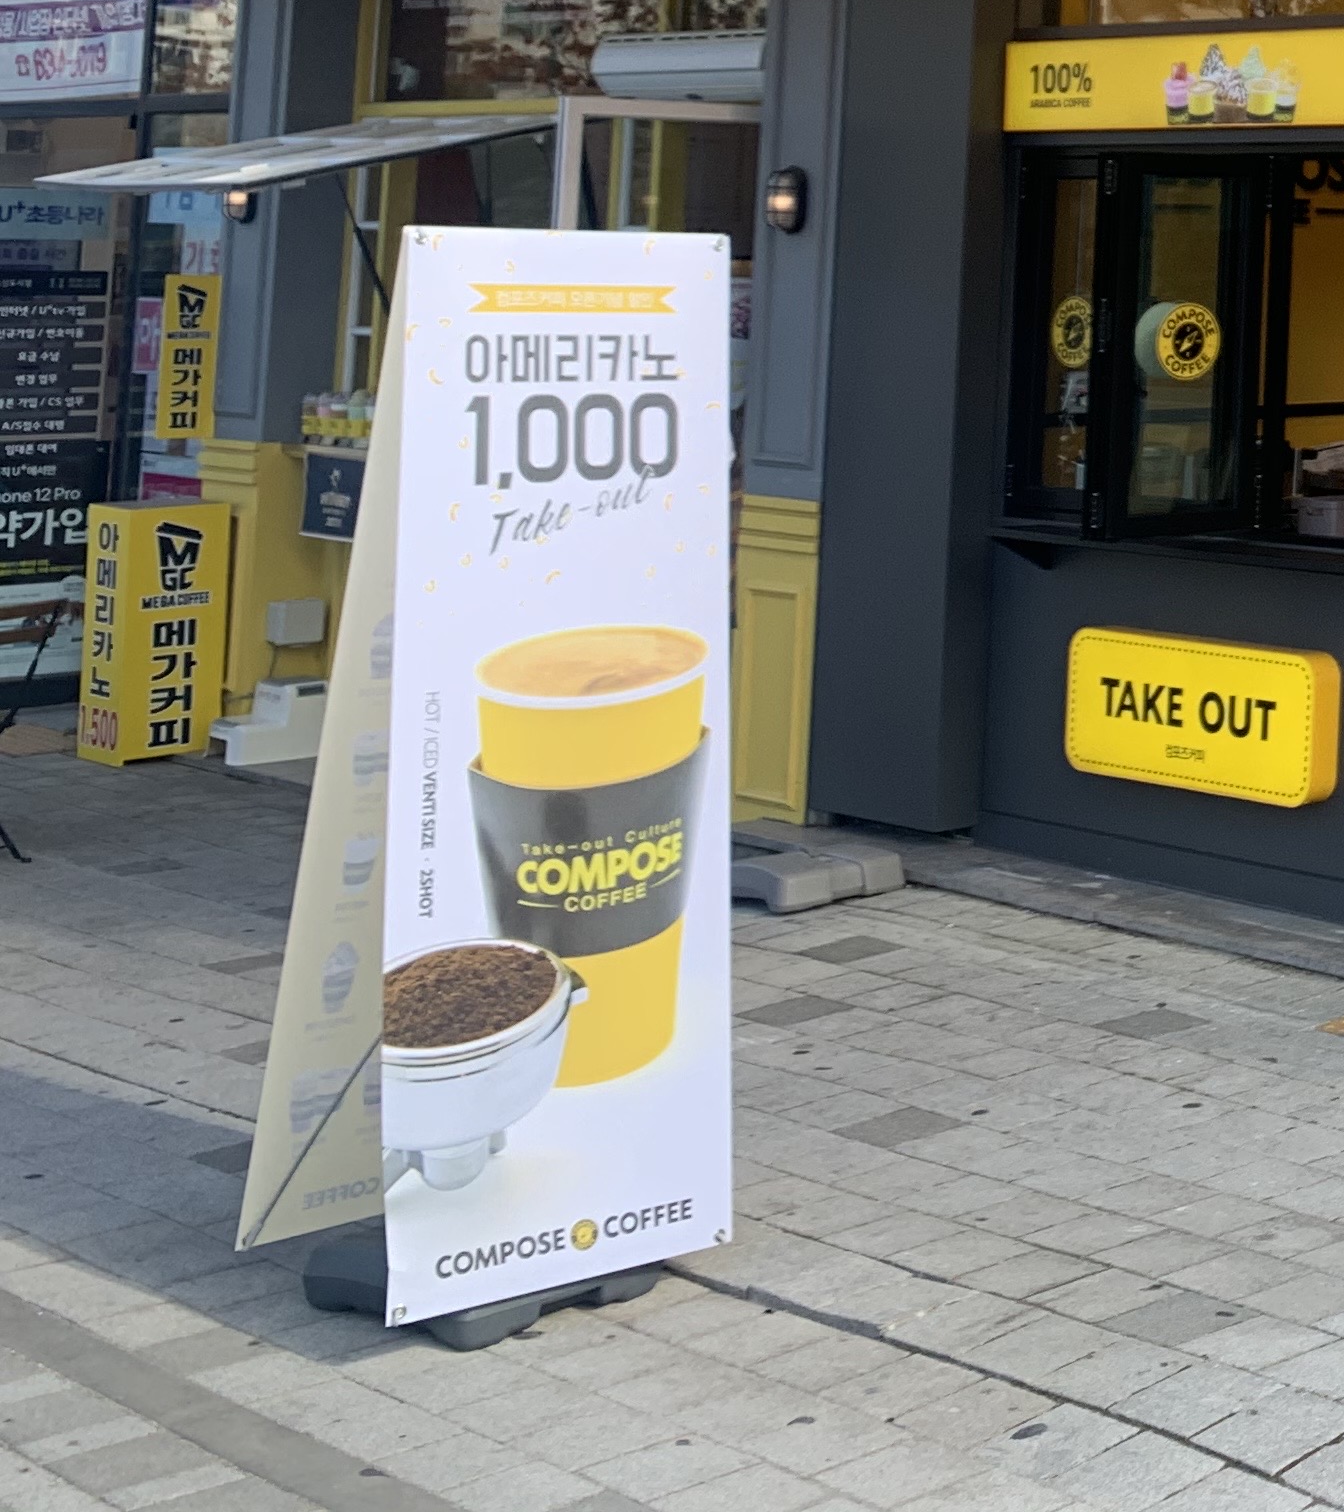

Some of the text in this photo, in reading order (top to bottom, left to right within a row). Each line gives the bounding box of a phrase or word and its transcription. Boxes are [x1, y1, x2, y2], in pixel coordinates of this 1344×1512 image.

[1029, 63, 1093, 95] 100%
[1063, 97, 1094, 108] COFFEE
[1160, 307, 1216, 340] COMPOSE
[465, 334, 679, 383] 아메리카노
[1164, 353, 1212, 376] COFFEE
[168, 347, 203, 430] 메가커피
[464, 392, 679, 489] 1,000
[34, 487, 51, 502] 12
[54, 487, 81, 501] Pro
[490, 465, 656, 556] Take-out
[89, 522, 120, 699] 아메리카노
[141, 591, 210, 610] MEGA COFFEE
[148, 619, 198, 748] 메가커피
[424, 691, 440, 724] HOT
[1100, 677, 1277, 741] TAKE OUT
[422, 739, 440, 770] ICED
[421, 770, 439, 815] VENTI
[420, 815, 437, 850] SIZE
[520, 817, 682, 856] Take-out Culture
[517, 830, 684, 897] COMPOSE
[418, 869, 435, 919] 2SHOT
[564, 882, 648, 913] COFFEE
[435, 1198, 693, 1279] COMPOSE COFFEE
